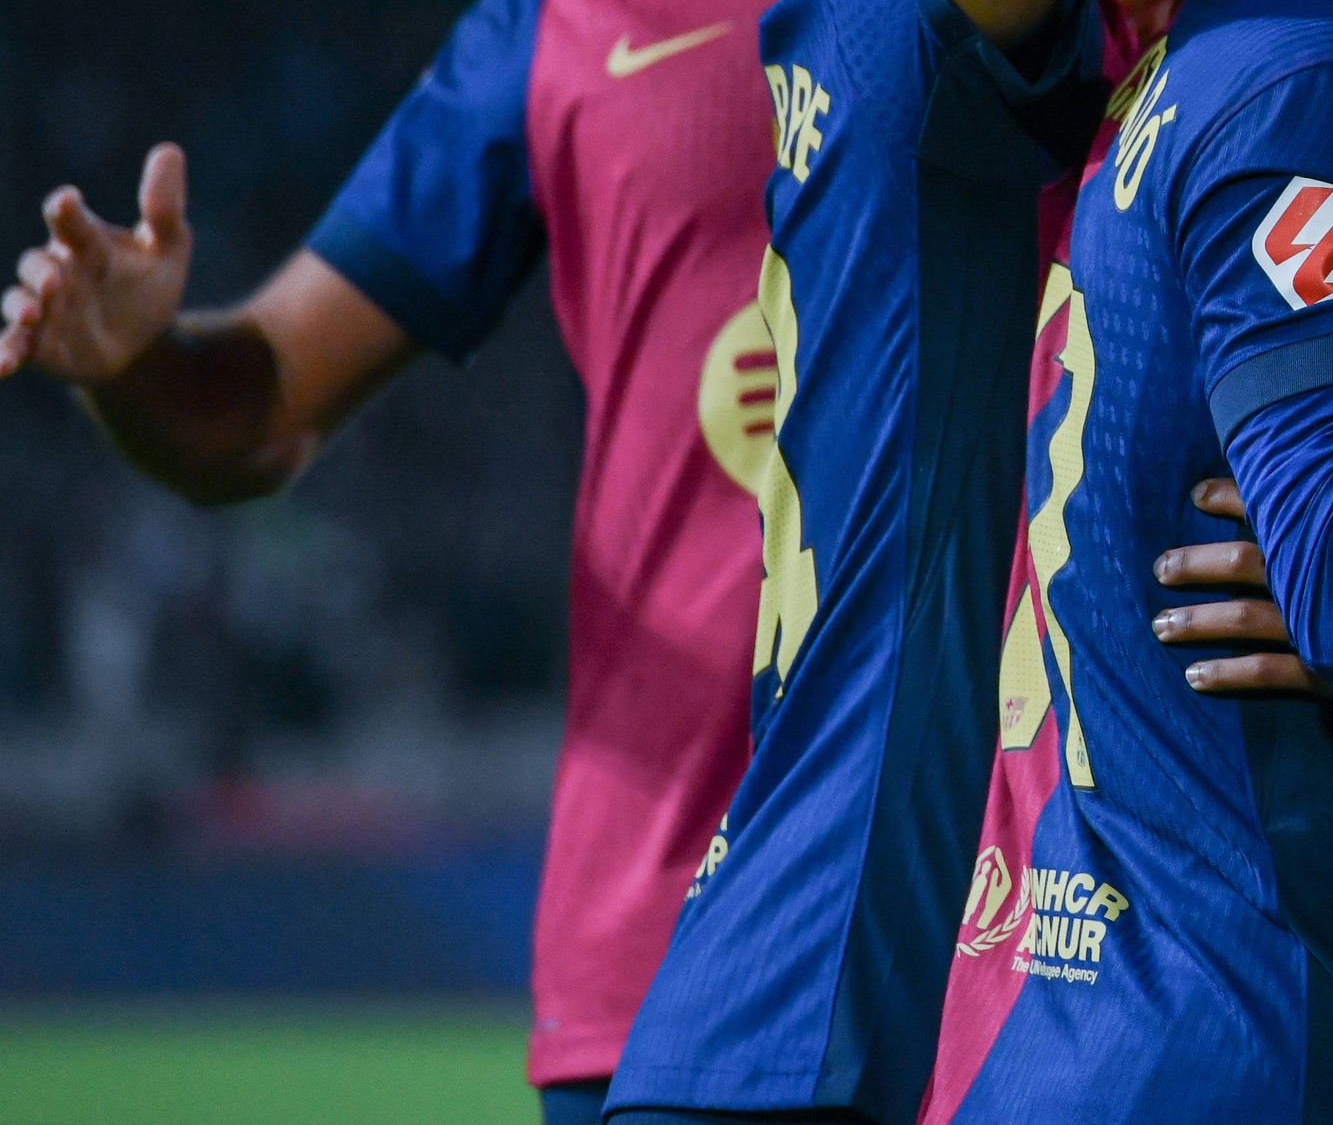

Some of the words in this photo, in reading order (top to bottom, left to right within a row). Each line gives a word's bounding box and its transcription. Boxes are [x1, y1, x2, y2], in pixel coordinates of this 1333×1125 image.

[1016, 913, 1107, 963] ACNUR
[1011, 956, 1030, 973] The
[1060, 964, 1099, 986] Agency
